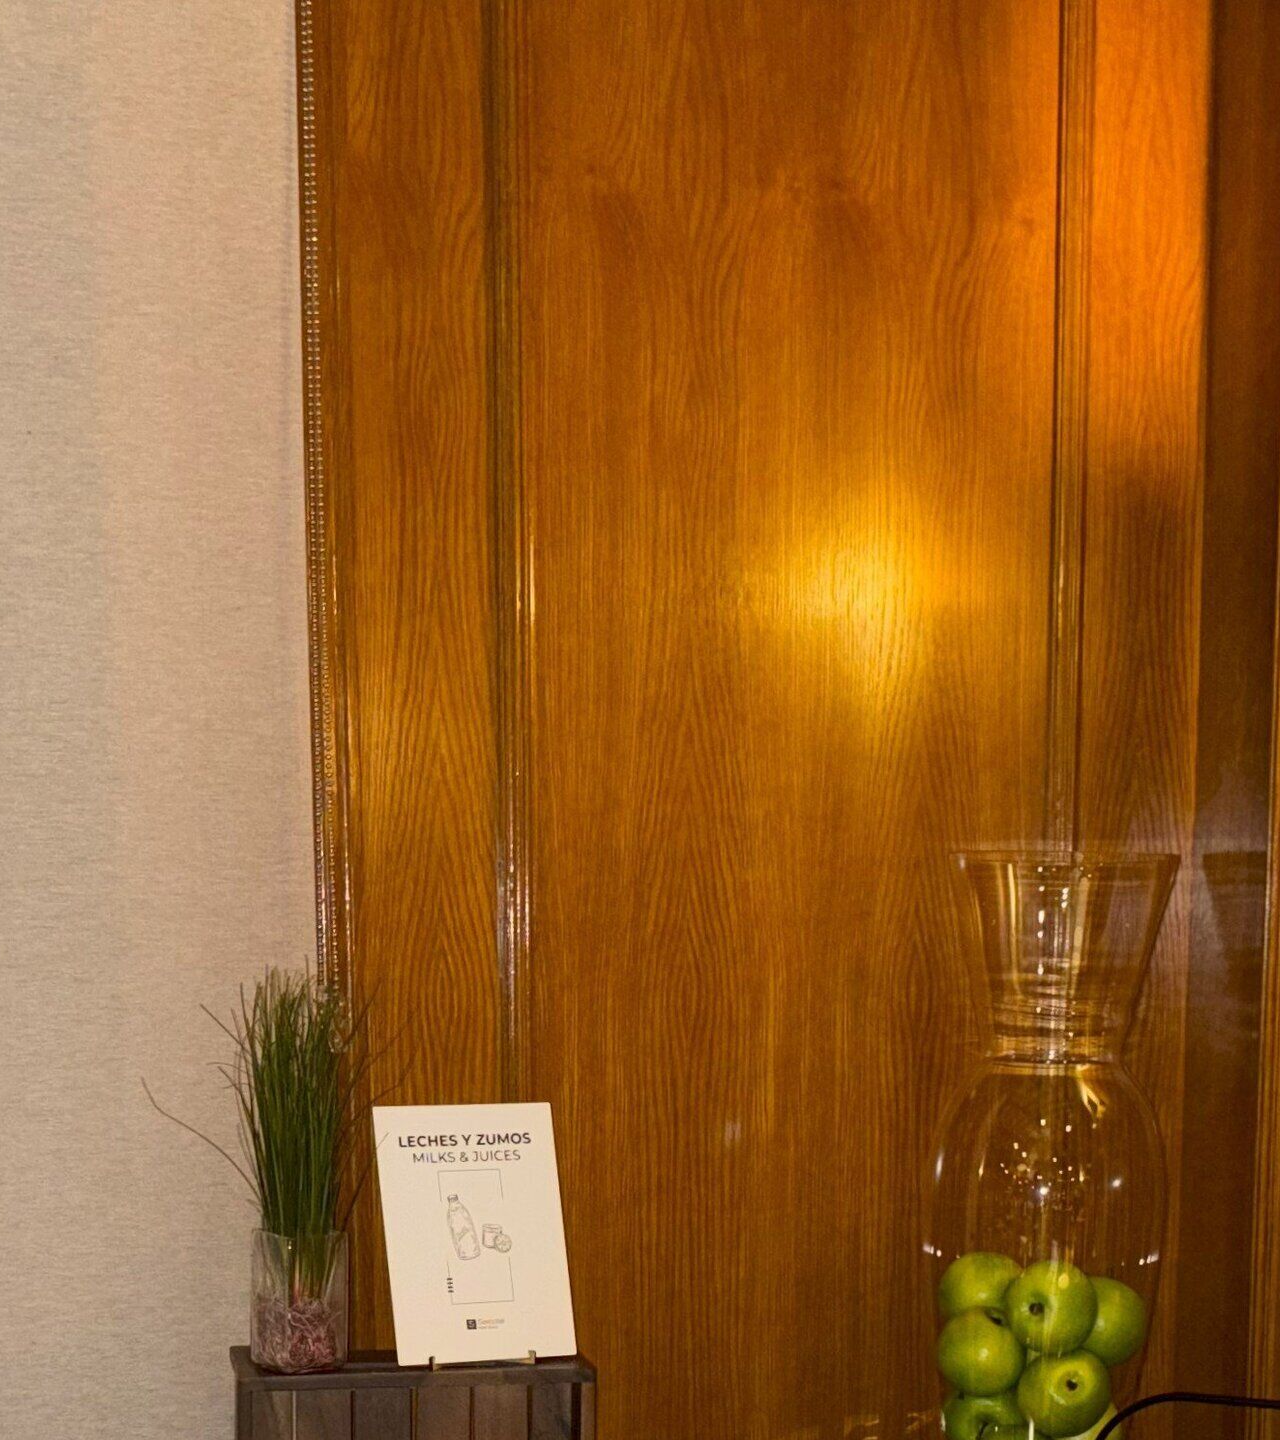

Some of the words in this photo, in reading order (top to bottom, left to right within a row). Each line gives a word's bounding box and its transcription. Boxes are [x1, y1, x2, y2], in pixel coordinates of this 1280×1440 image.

[398, 1135, 458, 1148] LECHES
[461, 1134, 472, 1146] Y
[476, 1132, 532, 1146] ZUMOS
[412, 1151, 456, 1164] MILKS
[459, 1151, 469, 1163] &
[472, 1149, 521, 1163] JUICES
